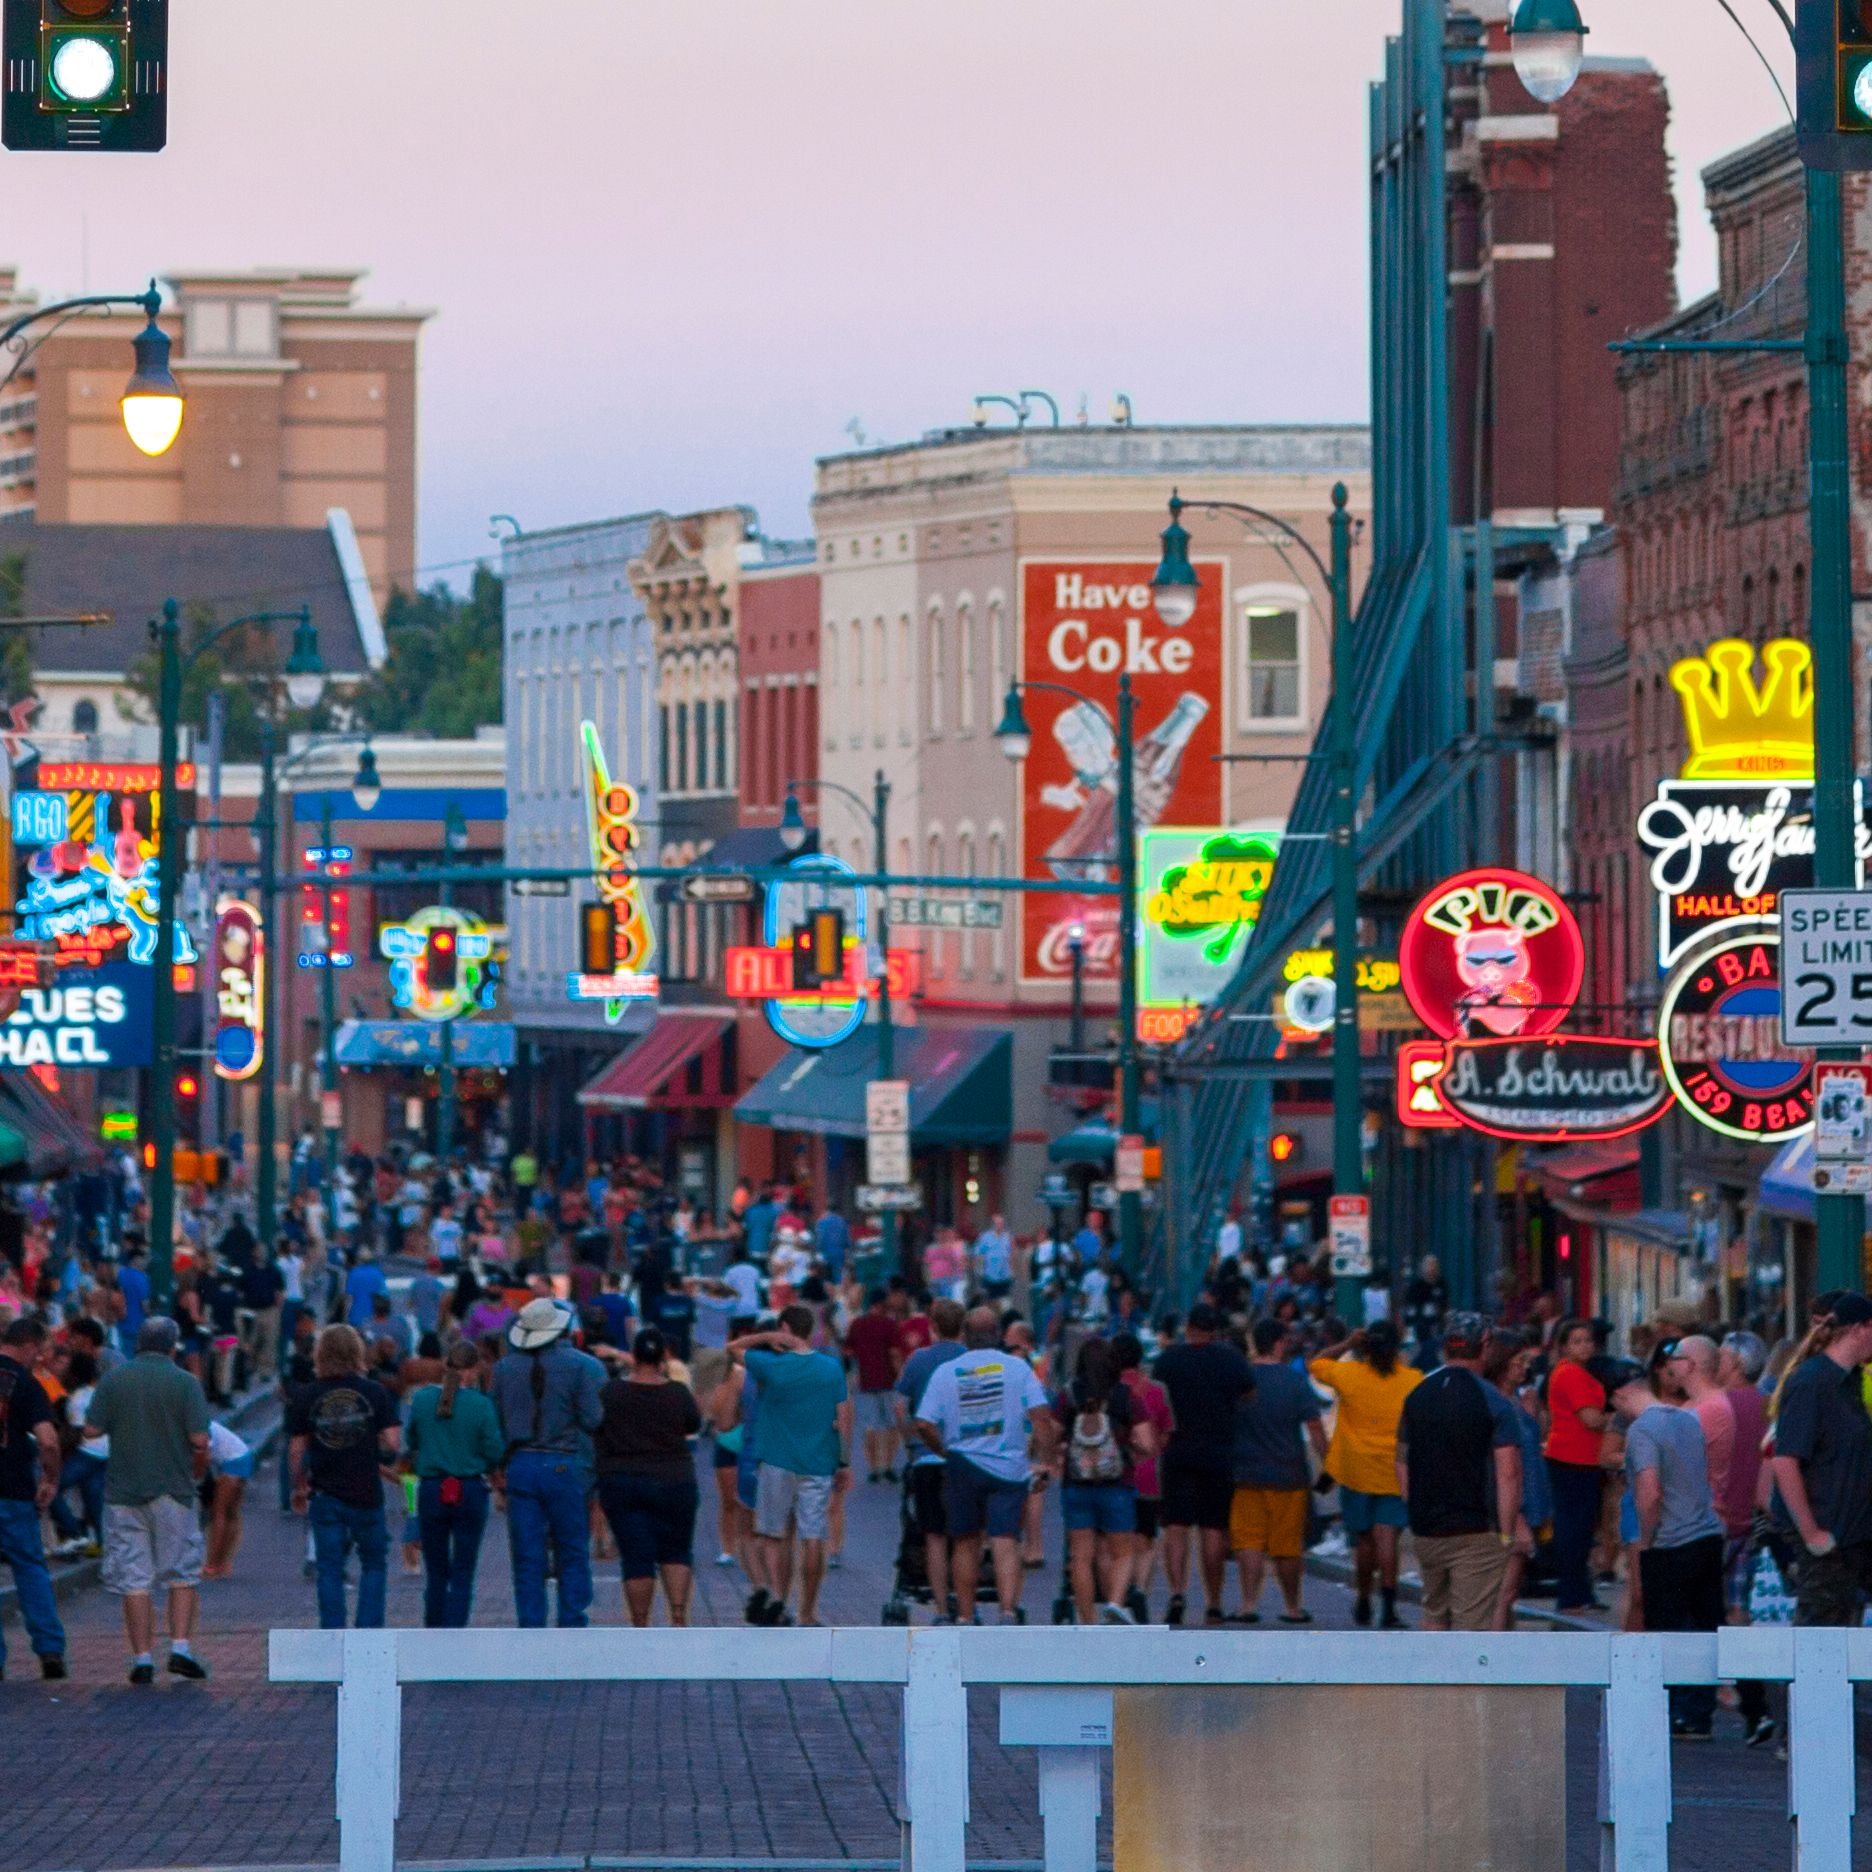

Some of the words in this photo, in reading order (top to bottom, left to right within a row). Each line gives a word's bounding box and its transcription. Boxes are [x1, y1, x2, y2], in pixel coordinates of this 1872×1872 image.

[1054, 572, 1151, 610] Have
[1047, 618, 1195, 674] Coke
[1424, 883, 1561, 939] PIG
[1678, 895, 1740, 917] HALL
[1742, 894, 1776, 914] OF
[1496, 1045, 1656, 1098] Schwab
[1684, 1071, 1733, 1114] 159
